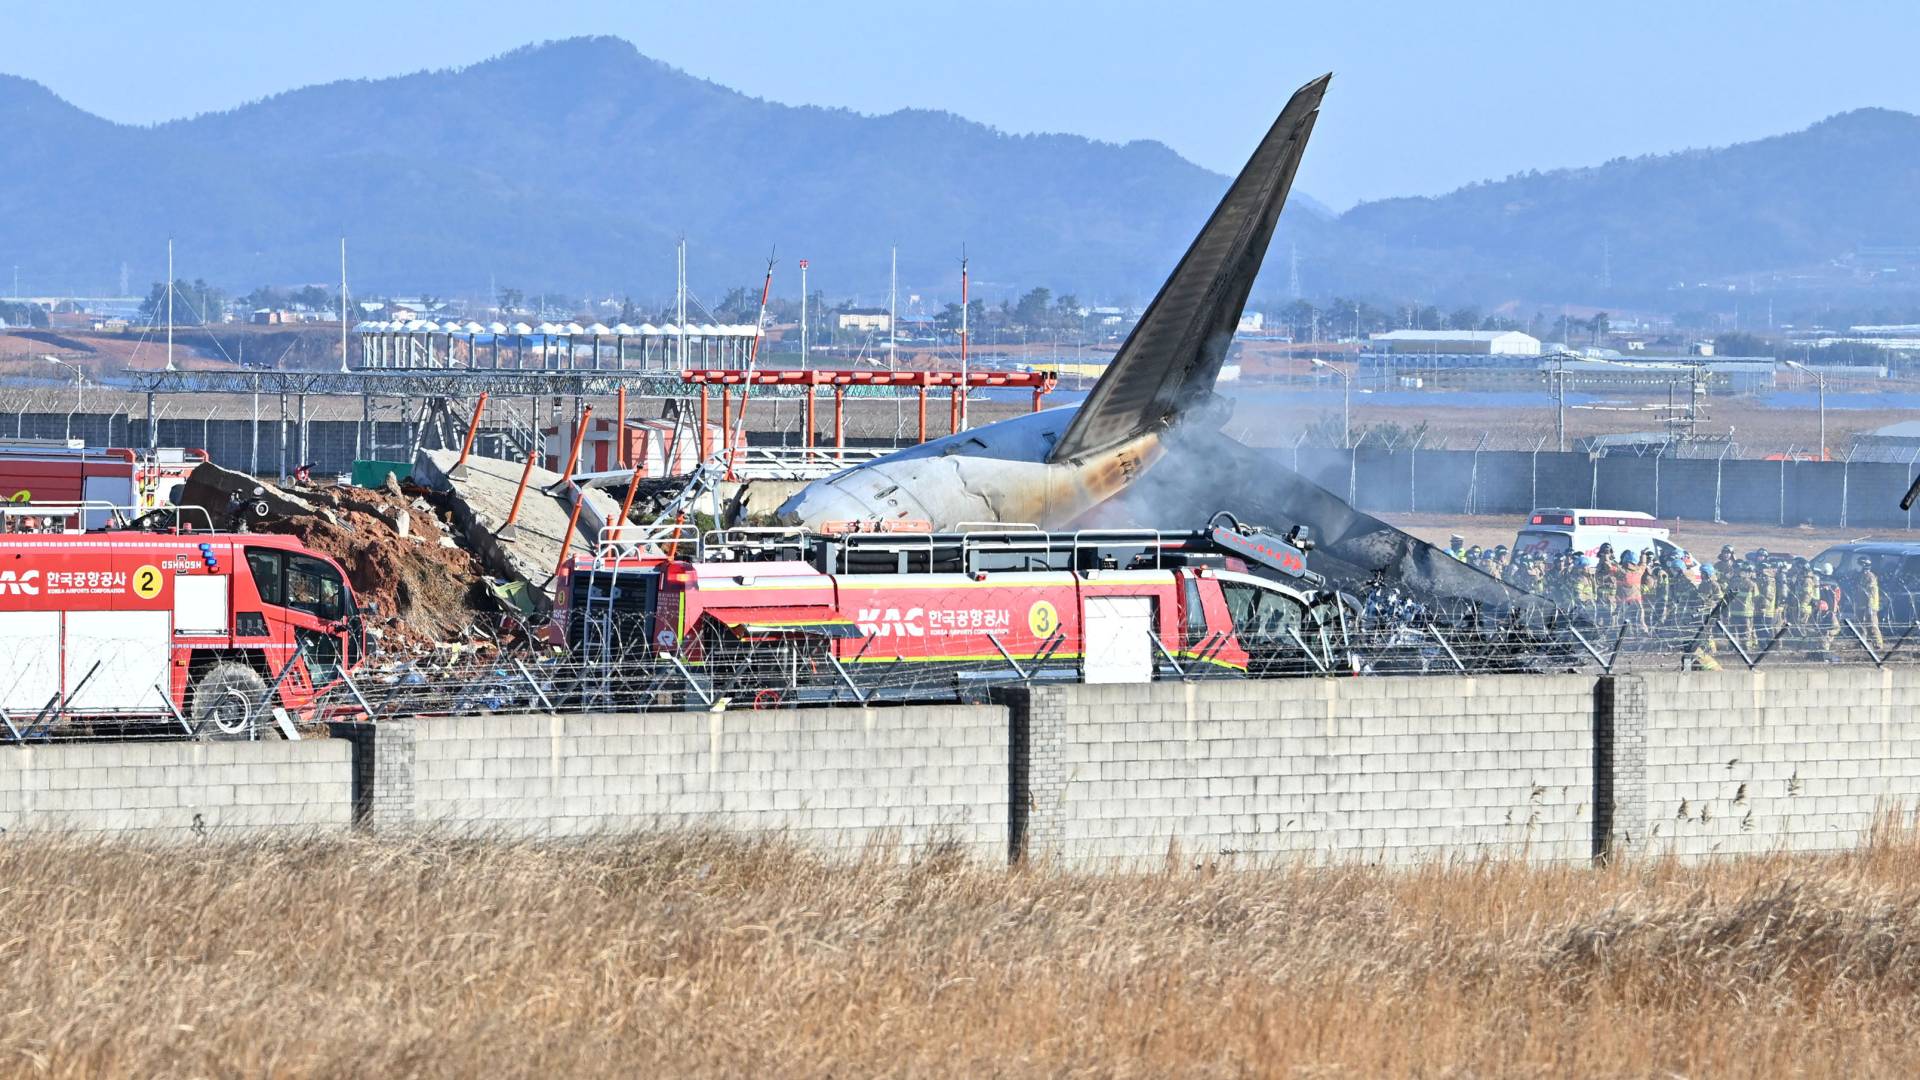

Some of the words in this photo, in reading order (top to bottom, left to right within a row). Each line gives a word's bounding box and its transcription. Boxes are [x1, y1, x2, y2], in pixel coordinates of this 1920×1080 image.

[161, 560, 202, 569] OSHKOSH
[47, 571, 127, 587] 한국공항공사
[141, 571, 154, 591] 2
[857, 607, 924, 637] KAC
[928, 608, 1010, 628] 한국공항공사
[1036, 607, 1049, 632] 3
